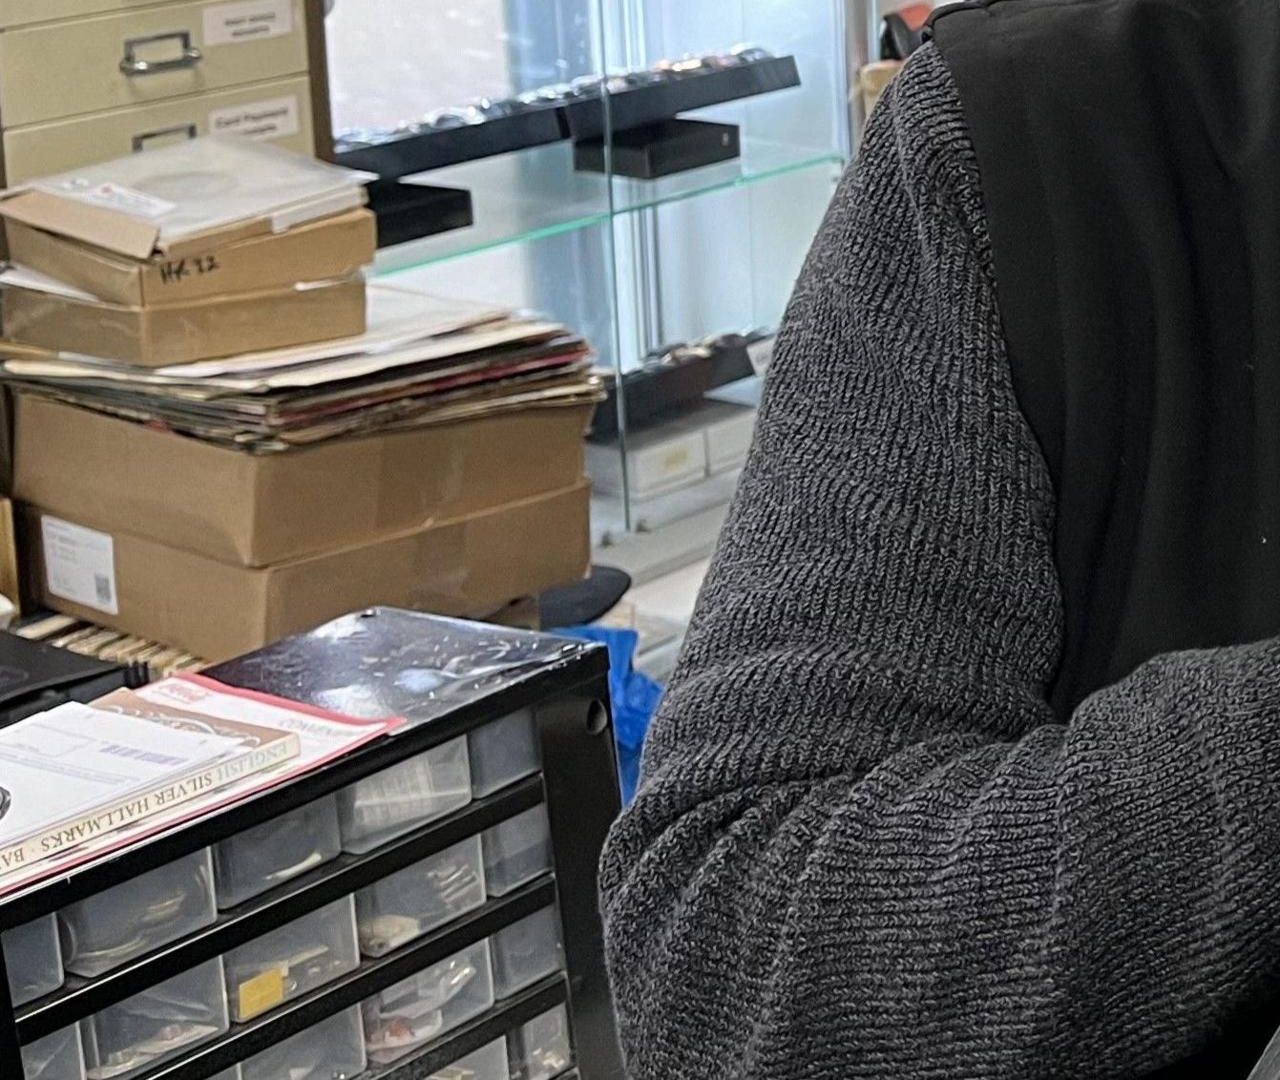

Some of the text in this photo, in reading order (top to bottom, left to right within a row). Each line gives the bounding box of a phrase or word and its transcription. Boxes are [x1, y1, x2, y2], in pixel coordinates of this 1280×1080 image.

[216, 743, 288, 780] ENGLISH
[155, 772, 214, 803] SILVER
[41, 797, 152, 853] HALLMARKS
